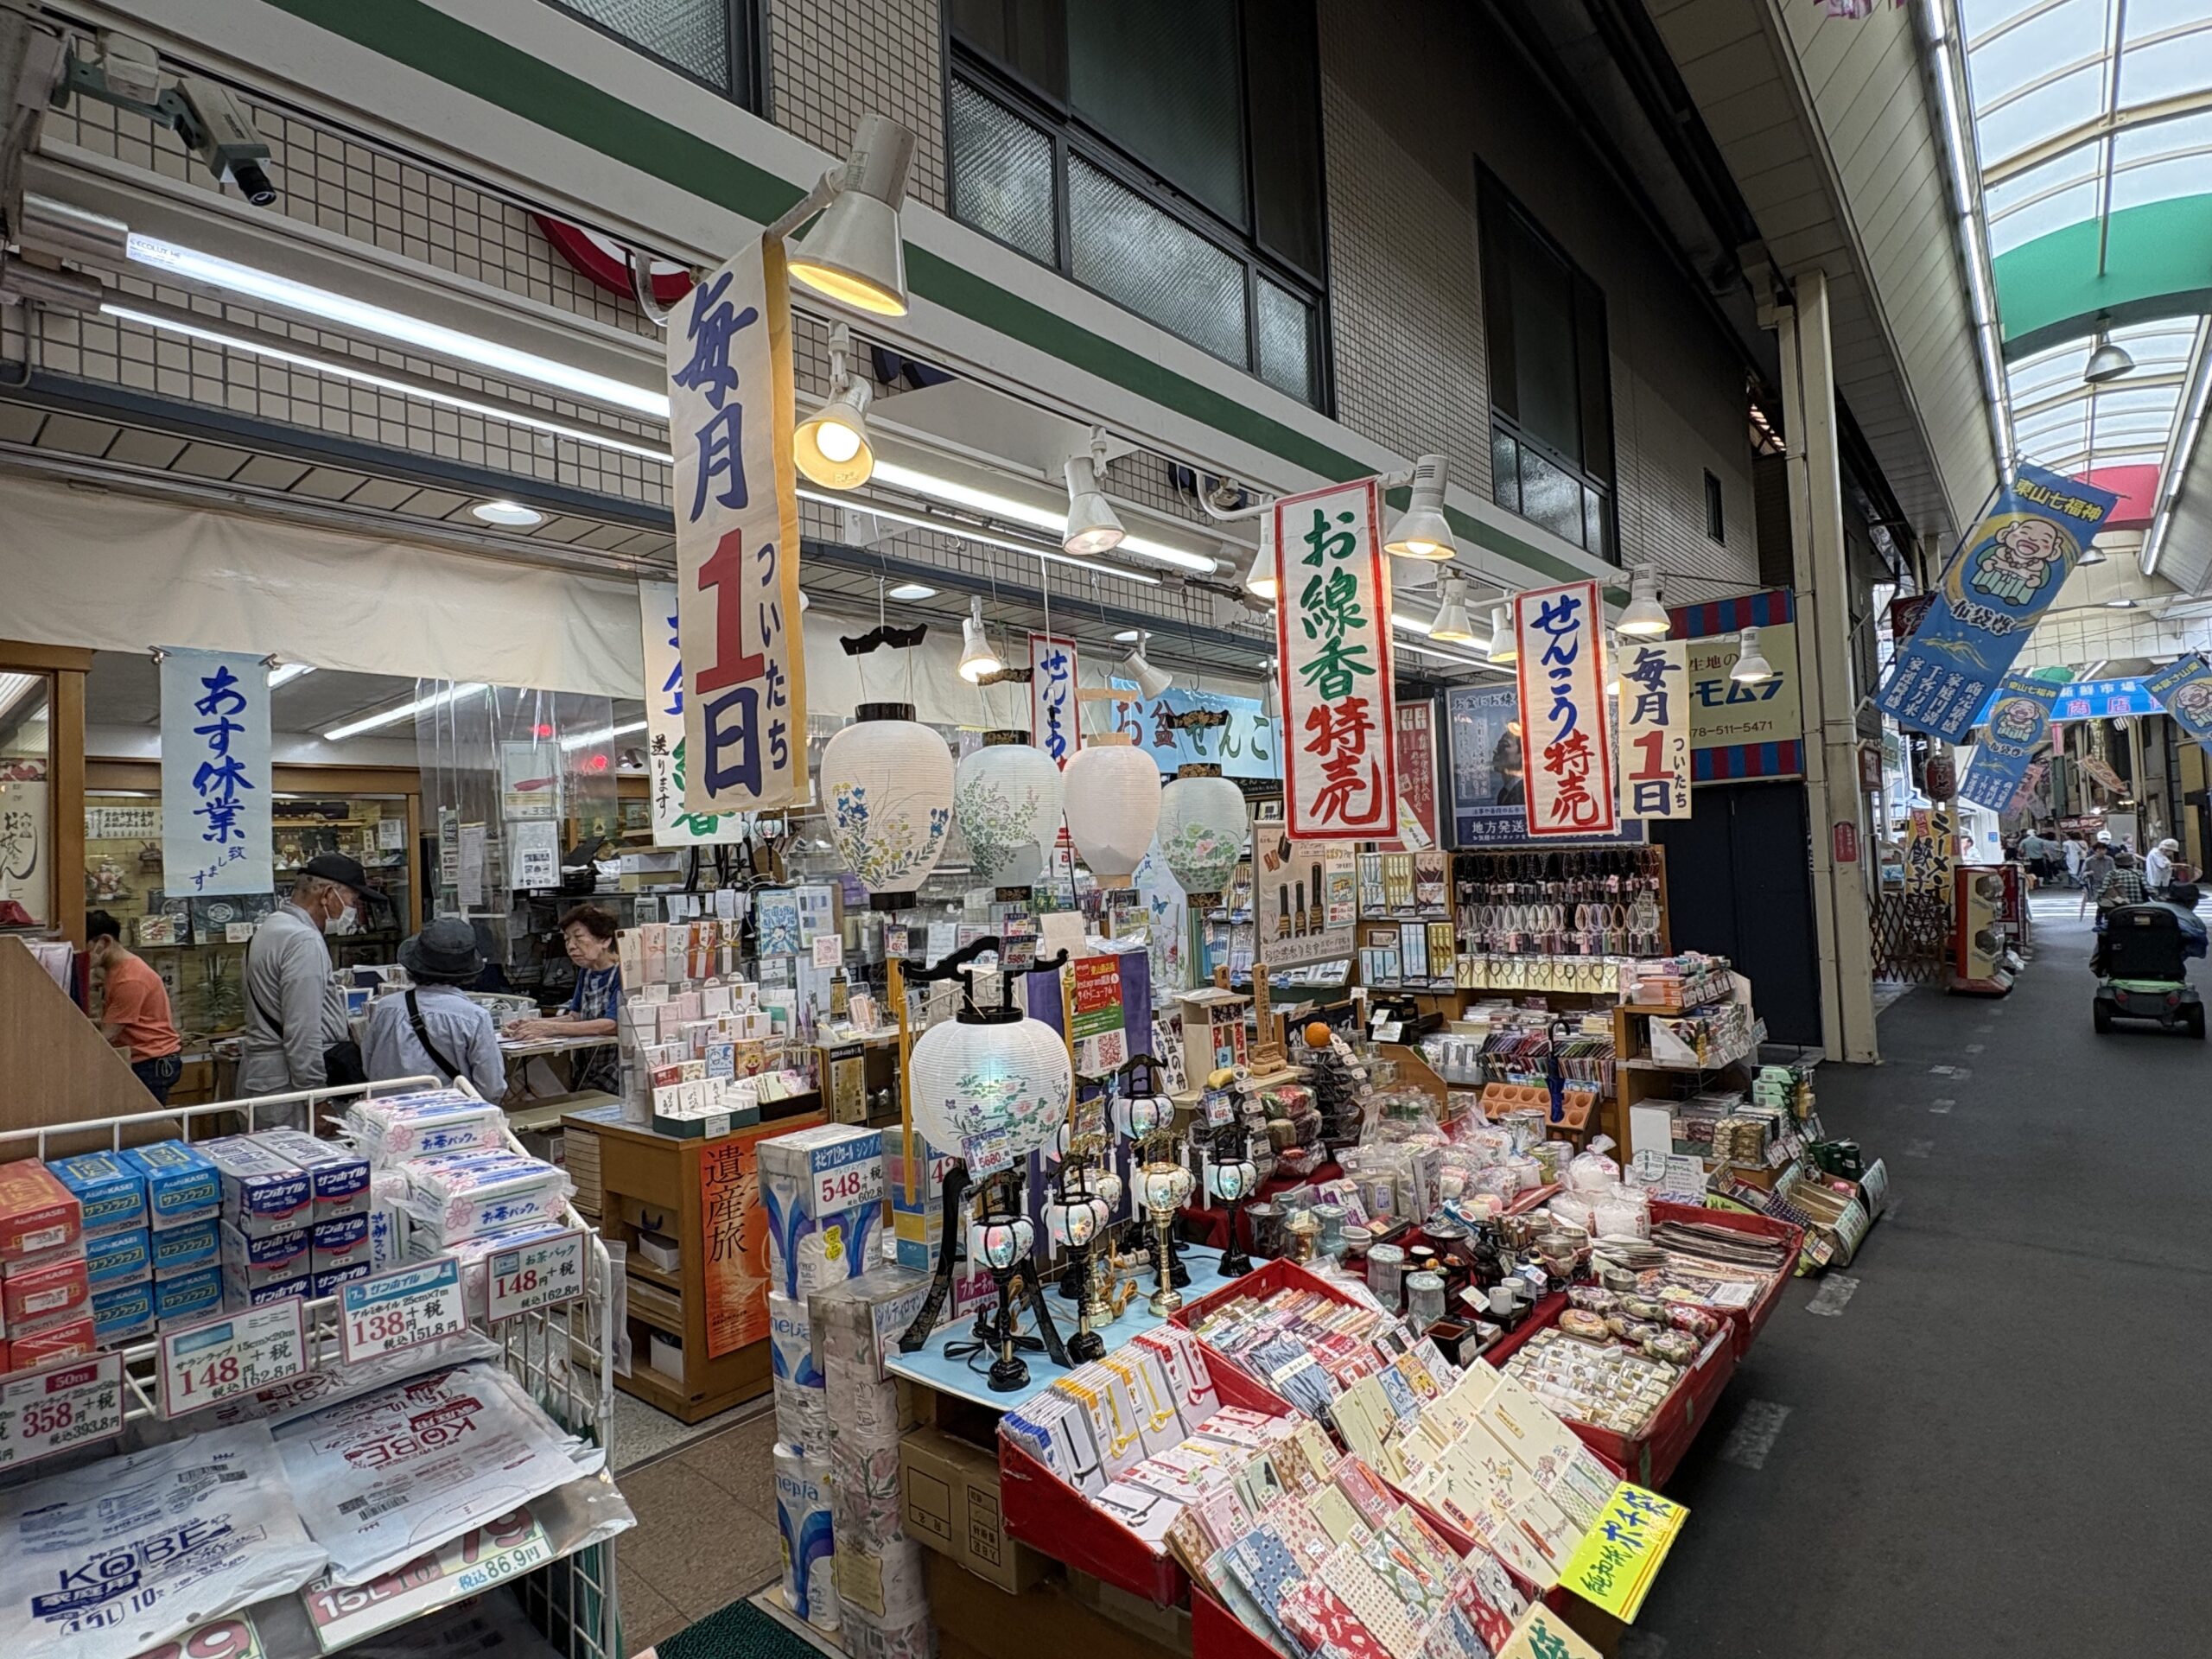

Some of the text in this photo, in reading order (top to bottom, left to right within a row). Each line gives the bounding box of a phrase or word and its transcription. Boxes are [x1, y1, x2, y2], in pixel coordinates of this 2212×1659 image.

[2012, 478, 2103, 524] 東山七福神
[671, 270, 766, 799] 毎月1日
[1951, 599, 2017, 636] 布袋尊
[758, 543, 789, 772] ついたち
[1300, 509, 1382, 825] お線香特売
[1689, 653, 1738, 671] 生地の
[1455, 692, 1518, 709] お盆にお線
[1689, 671, 1783, 707] モムラ
[1530, 594, 1599, 825] せんこう特売
[1622, 647, 1681, 816] 毎月1日
[193, 665, 255, 844] あす休業
[651, 734, 671, 818] 送ります
[1673, 738, 1687, 808] ついたち
[1472, 821, 1527, 834] 地方発送
[189, 846, 246, 891] 致します
[421, 1133, 474, 1150] お茶パック
[252, 1182, 306, 1201] サンホイル
[317, 1166, 367, 1185] サンホイル
[162, 1185, 212, 1206] サランラップ
[481, 1203, 535, 1224] お茶パック
[706, 1145, 748, 1265] 遺産旅
[251, 1230, 306, 1252] サンホイル
[315, 1218, 365, 1236] サンホイル
[88, 1249, 143, 1270] サランラップ
[525, 1244, 576, 1266] お茶パック
[370, 1274, 420, 1295] サンホイル
[60, 1521, 209, 1590] KOBE
